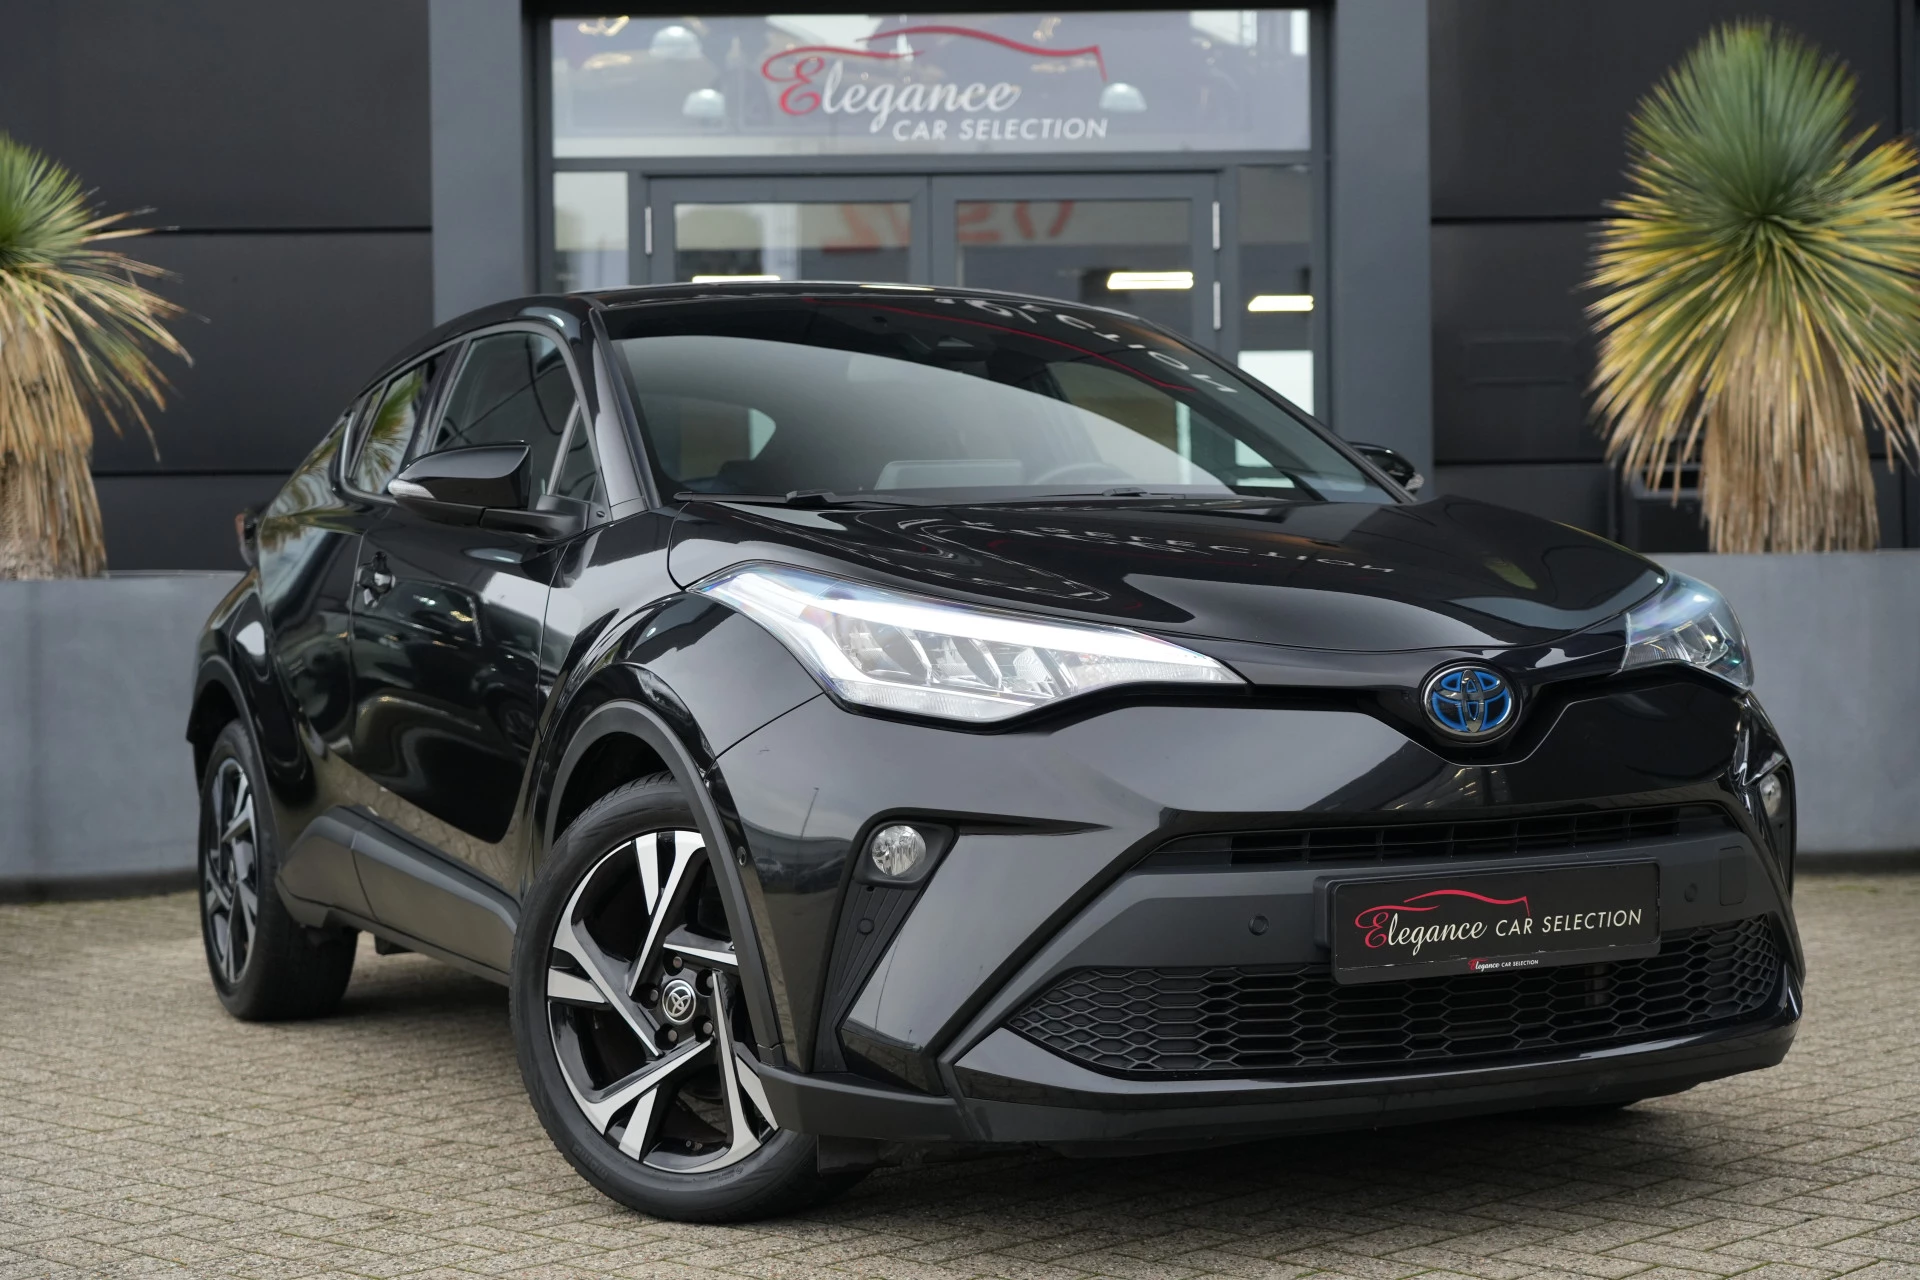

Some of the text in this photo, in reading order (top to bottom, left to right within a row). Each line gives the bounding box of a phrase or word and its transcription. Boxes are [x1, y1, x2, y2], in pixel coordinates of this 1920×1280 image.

[762, 47, 1022, 133] Elegance
[892, 117, 1108, 142] CAR SELECTION
[1354, 905, 1642, 956] Elegance CAR SELECTION
[1512, 959, 1539, 967] SELECTION
